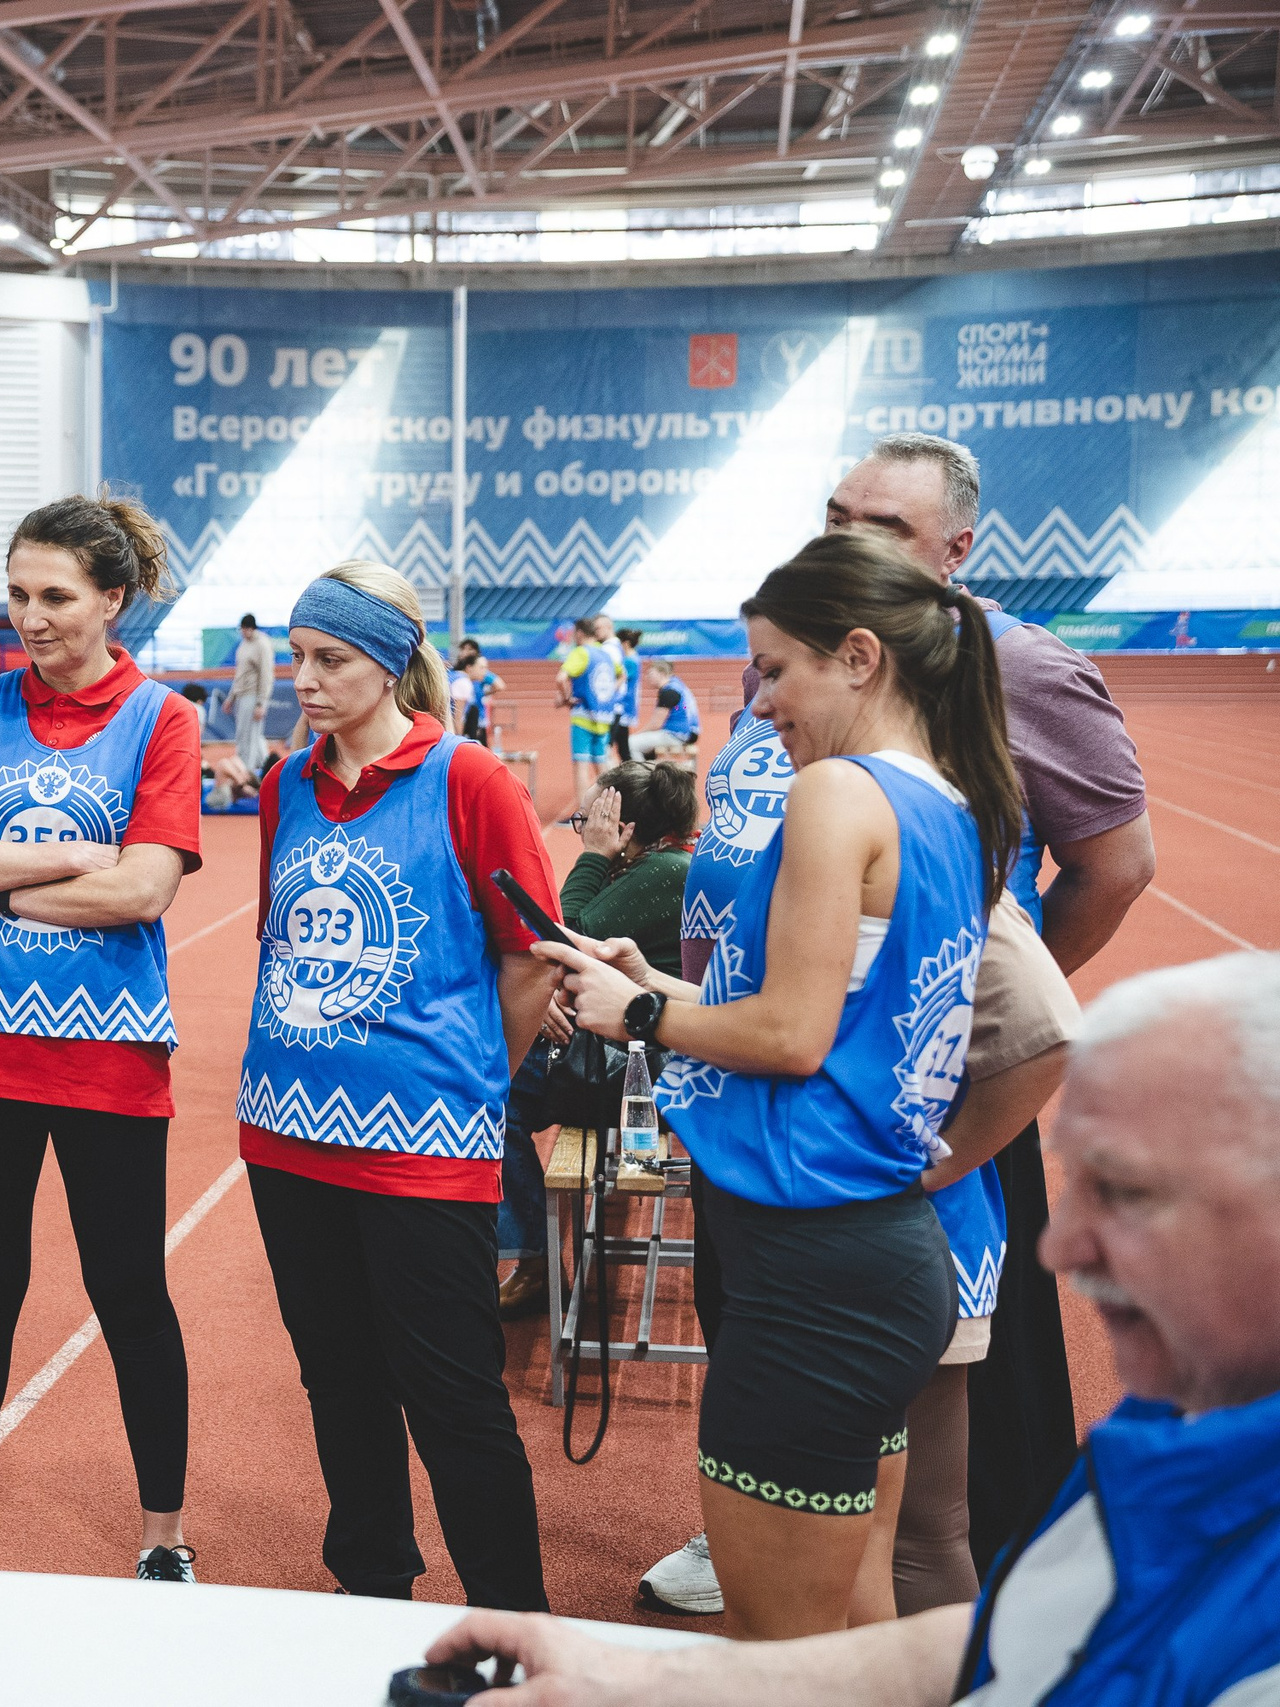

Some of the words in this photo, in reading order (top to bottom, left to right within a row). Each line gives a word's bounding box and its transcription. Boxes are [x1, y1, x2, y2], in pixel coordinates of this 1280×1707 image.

[958, 320, 1031, 345] СПОРТ
[169, 332, 248, 387] 90
[269, 347, 384, 388] лет
[958, 342, 1047, 366] НОРМА
[957, 363, 1046, 389] ЖИЗНИ
[1211, 384, 1280, 416] ко
[495, 471, 522, 497] и
[742, 747, 797, 778] 39
[746, 792, 788, 812] ГТ
[294, 907, 354, 945] 333
[292, 959, 335, 984] ГТО
